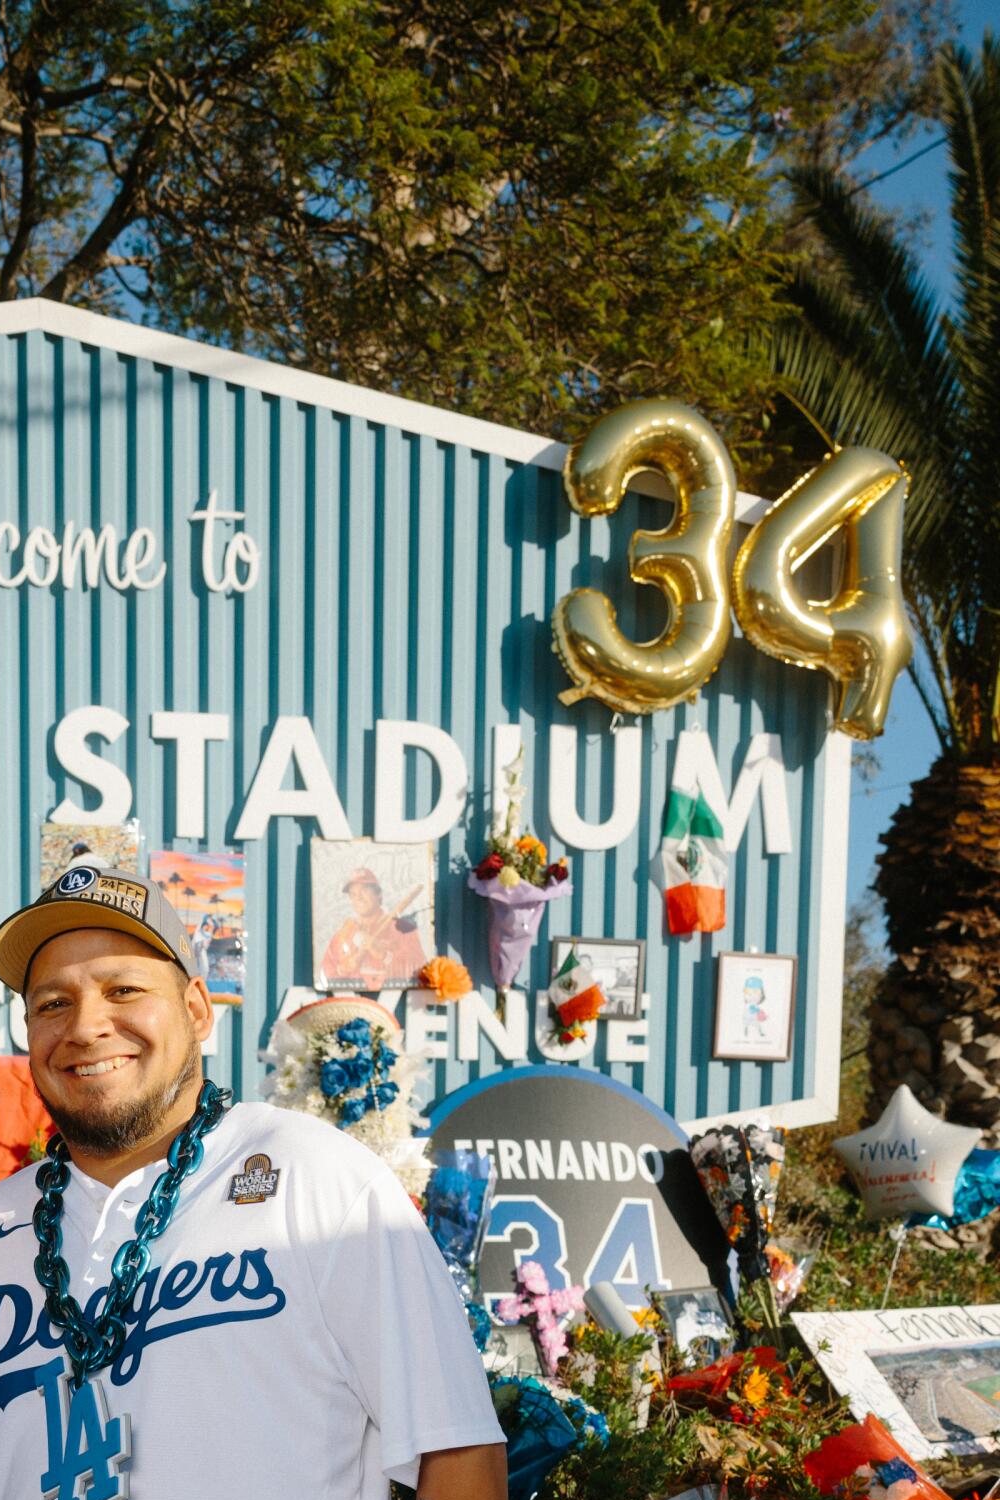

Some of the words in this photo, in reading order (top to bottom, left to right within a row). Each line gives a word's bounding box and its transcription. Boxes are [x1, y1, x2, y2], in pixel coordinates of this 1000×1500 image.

[188, 489, 260, 594] to
[552, 399, 913, 742] 34
[48, 704, 791, 854] STADIUM
[100, 878, 116, 890] 24
[262, 984, 651, 1064] AENUE
[232, 1183, 275, 1198] SERIES
[234, 1173, 278, 1188] WORLD
[482, 1194, 673, 1328] 34
